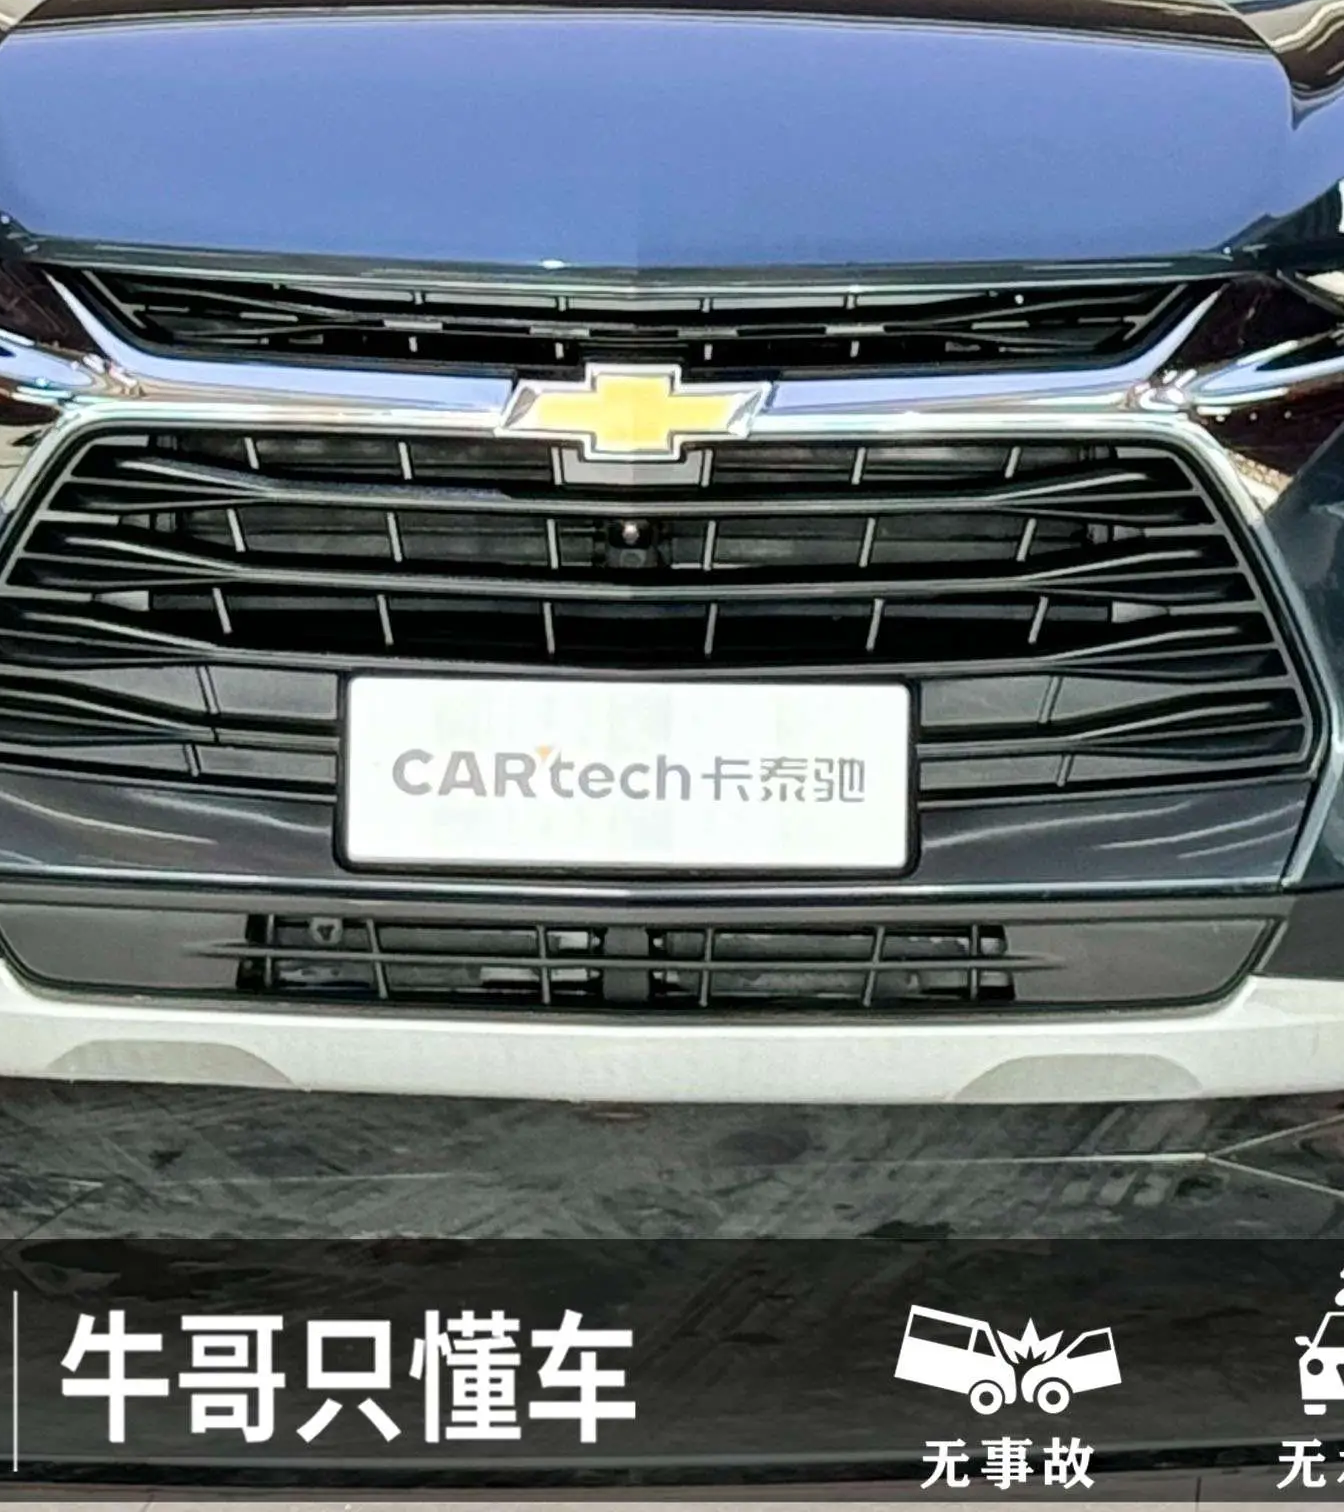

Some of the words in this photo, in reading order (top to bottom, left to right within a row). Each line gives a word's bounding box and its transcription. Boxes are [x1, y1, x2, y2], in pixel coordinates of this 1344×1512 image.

[391, 748, 692, 801] CARtech
[700, 755, 866, 803] 卡泰驰
